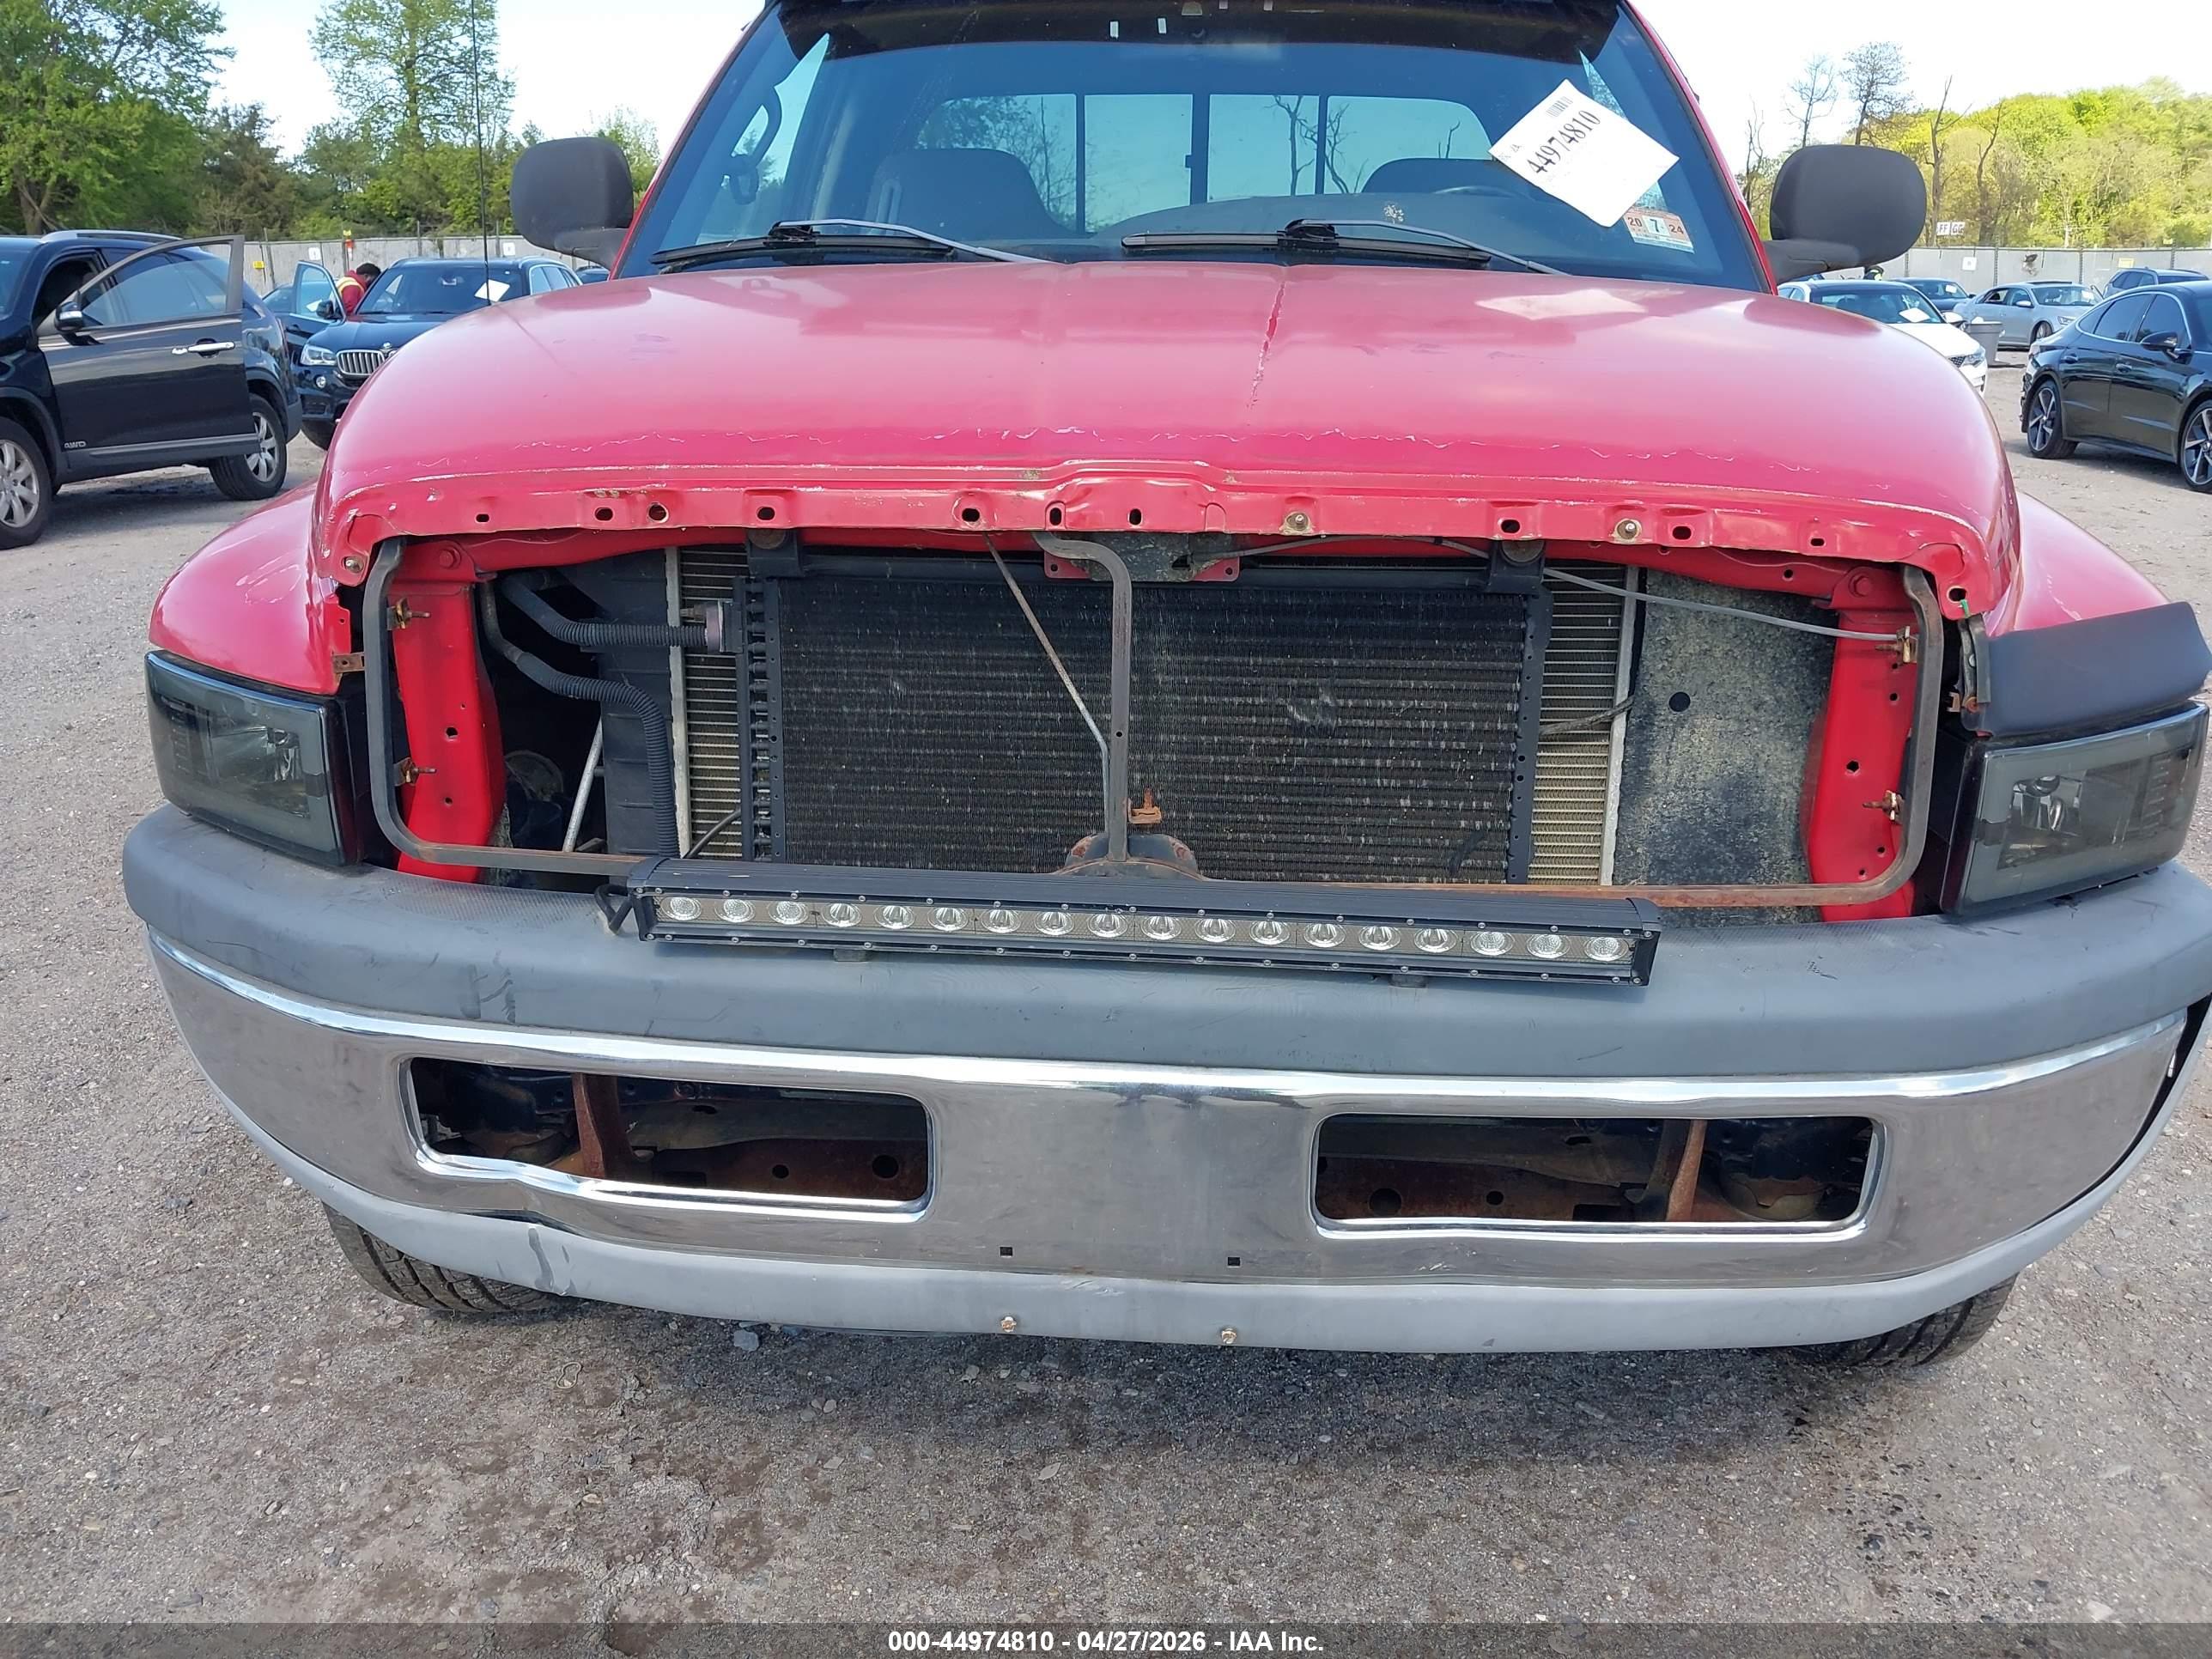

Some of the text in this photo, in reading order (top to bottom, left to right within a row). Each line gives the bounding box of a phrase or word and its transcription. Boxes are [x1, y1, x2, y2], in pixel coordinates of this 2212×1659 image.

[1526, 109, 1601, 173] 44974810
[1627, 216, 1684, 234] 20 7 24
